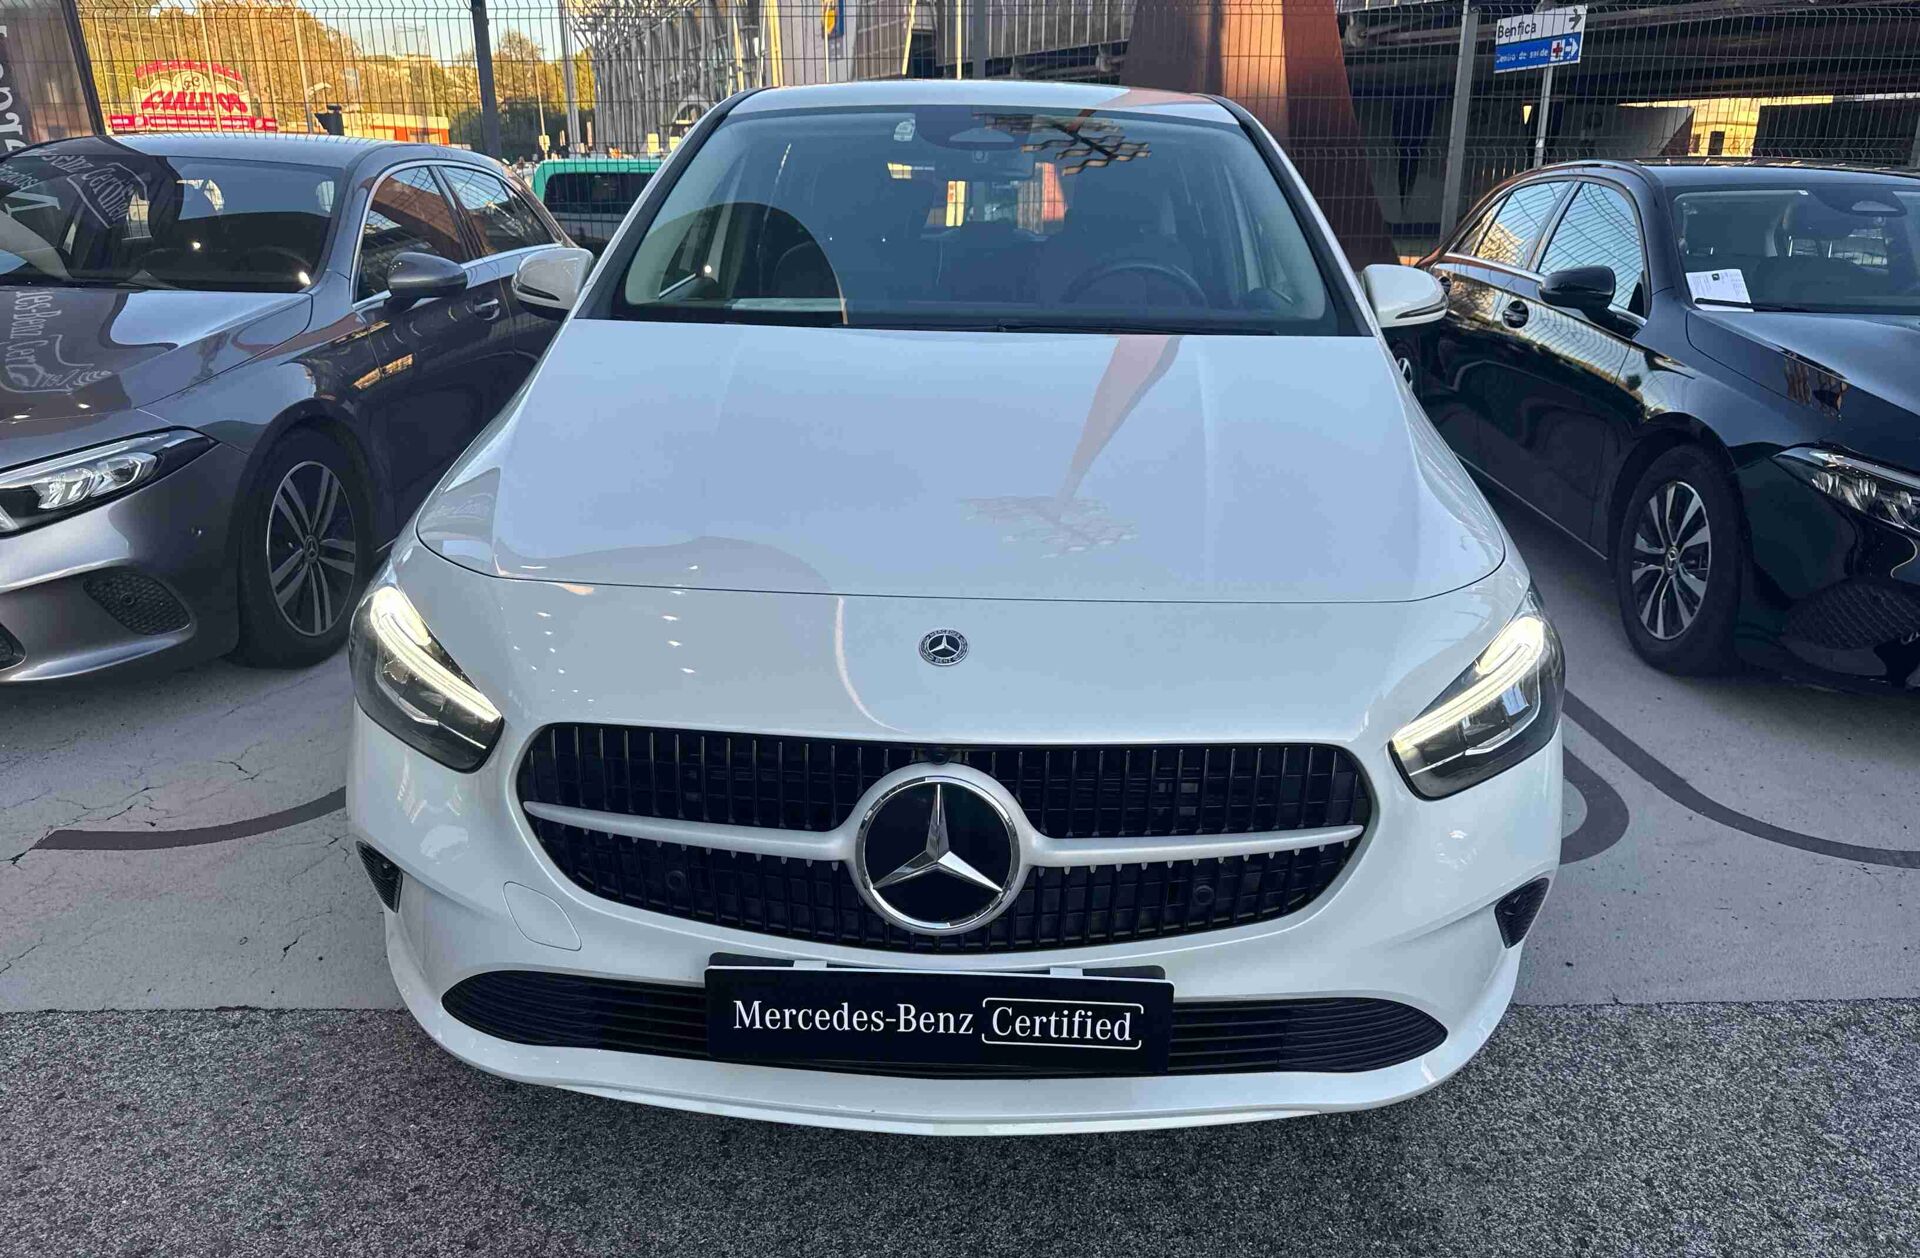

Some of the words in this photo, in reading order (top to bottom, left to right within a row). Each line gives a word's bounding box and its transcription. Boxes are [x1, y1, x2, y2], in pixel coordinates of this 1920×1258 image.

[1497, 22, 1536, 38] Benfica
[733, 1000, 974, 1035] Mercedes-Benz
[991, 1006, 1132, 1041] Certified
